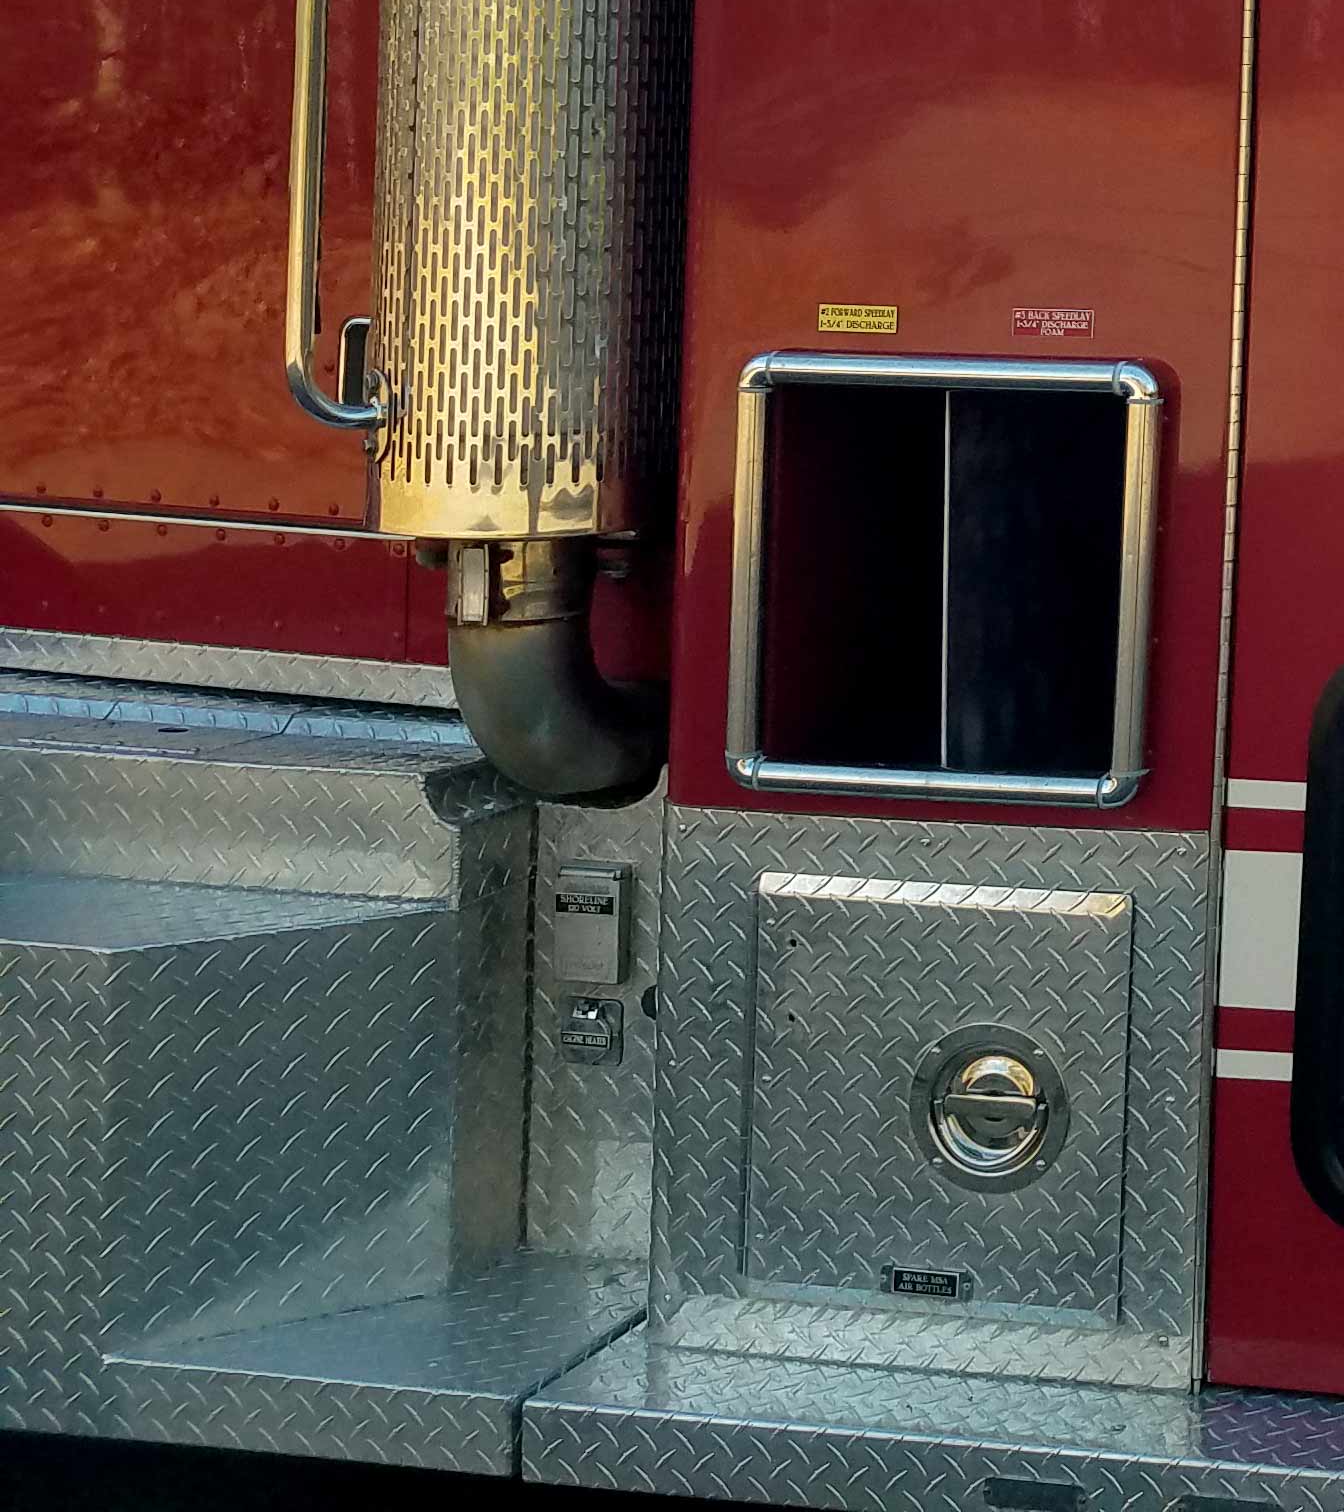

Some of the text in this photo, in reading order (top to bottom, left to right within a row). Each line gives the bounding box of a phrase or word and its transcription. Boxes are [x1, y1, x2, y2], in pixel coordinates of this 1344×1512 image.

[1028, 310, 1051, 320] BACK
[846, 320, 895, 330] DISCHARGE
[1041, 320, 1088, 329] DISCHARGE
[560, 895, 609, 905] SHORELINE
[902, 1273, 929, 1282] SPARE
[898, 1282, 952, 1294] AIR BOTTLES
